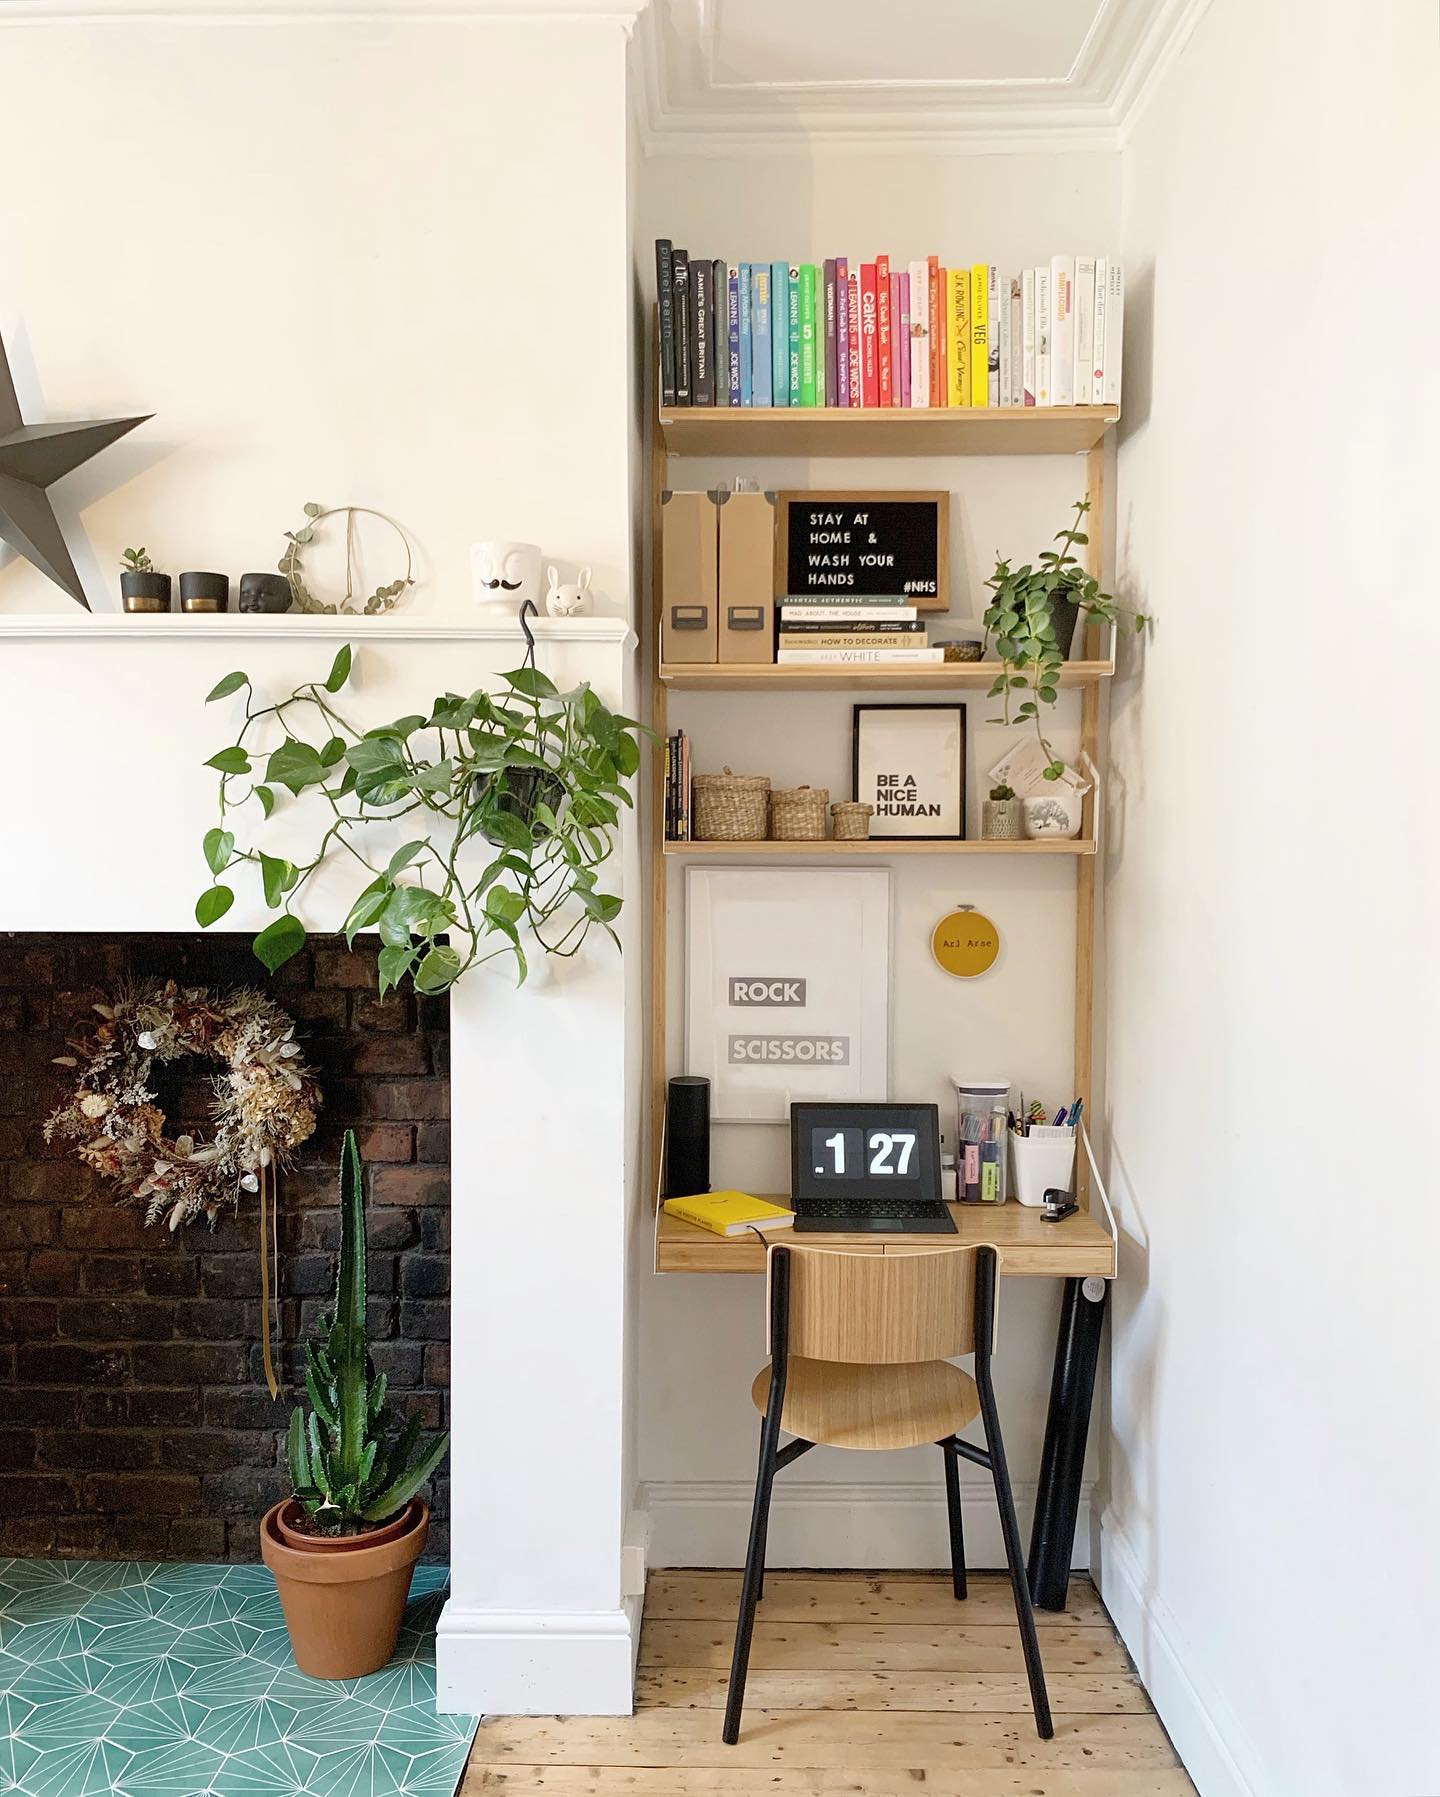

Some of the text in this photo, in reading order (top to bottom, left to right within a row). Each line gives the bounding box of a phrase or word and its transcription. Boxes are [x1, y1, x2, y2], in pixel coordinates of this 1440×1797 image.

[675, 266, 687, 286] Life
[661, 247, 671, 338] planet earth
[697, 271, 705, 307] JAMIE'S
[863, 291, 874, 335] cake
[803, 324, 812, 339] 5
[974, 324, 986, 345] VEG
[698, 341, 706, 379] BRITAIN
[850, 348, 858, 398] JOE WICKS
[810, 514, 869, 525] STAY AT
[810, 532, 878, 544] HOME &
[808, 554, 895, 567] WASH YOUR
[808, 574, 855, 586] HANDS
[904, 581, 937, 593] #NHS
[840, 652, 880, 661] WHITE
[877, 774, 917, 787] BE A
[877, 789, 917, 802] NICE
[876, 804, 941, 816] HUMAN
[967, 940, 992, 948] Arse
[734, 982, 801, 1002] ROCK
[733, 1040, 844, 1060] SCISSORS
[869, 1133, 916, 1174] 27
